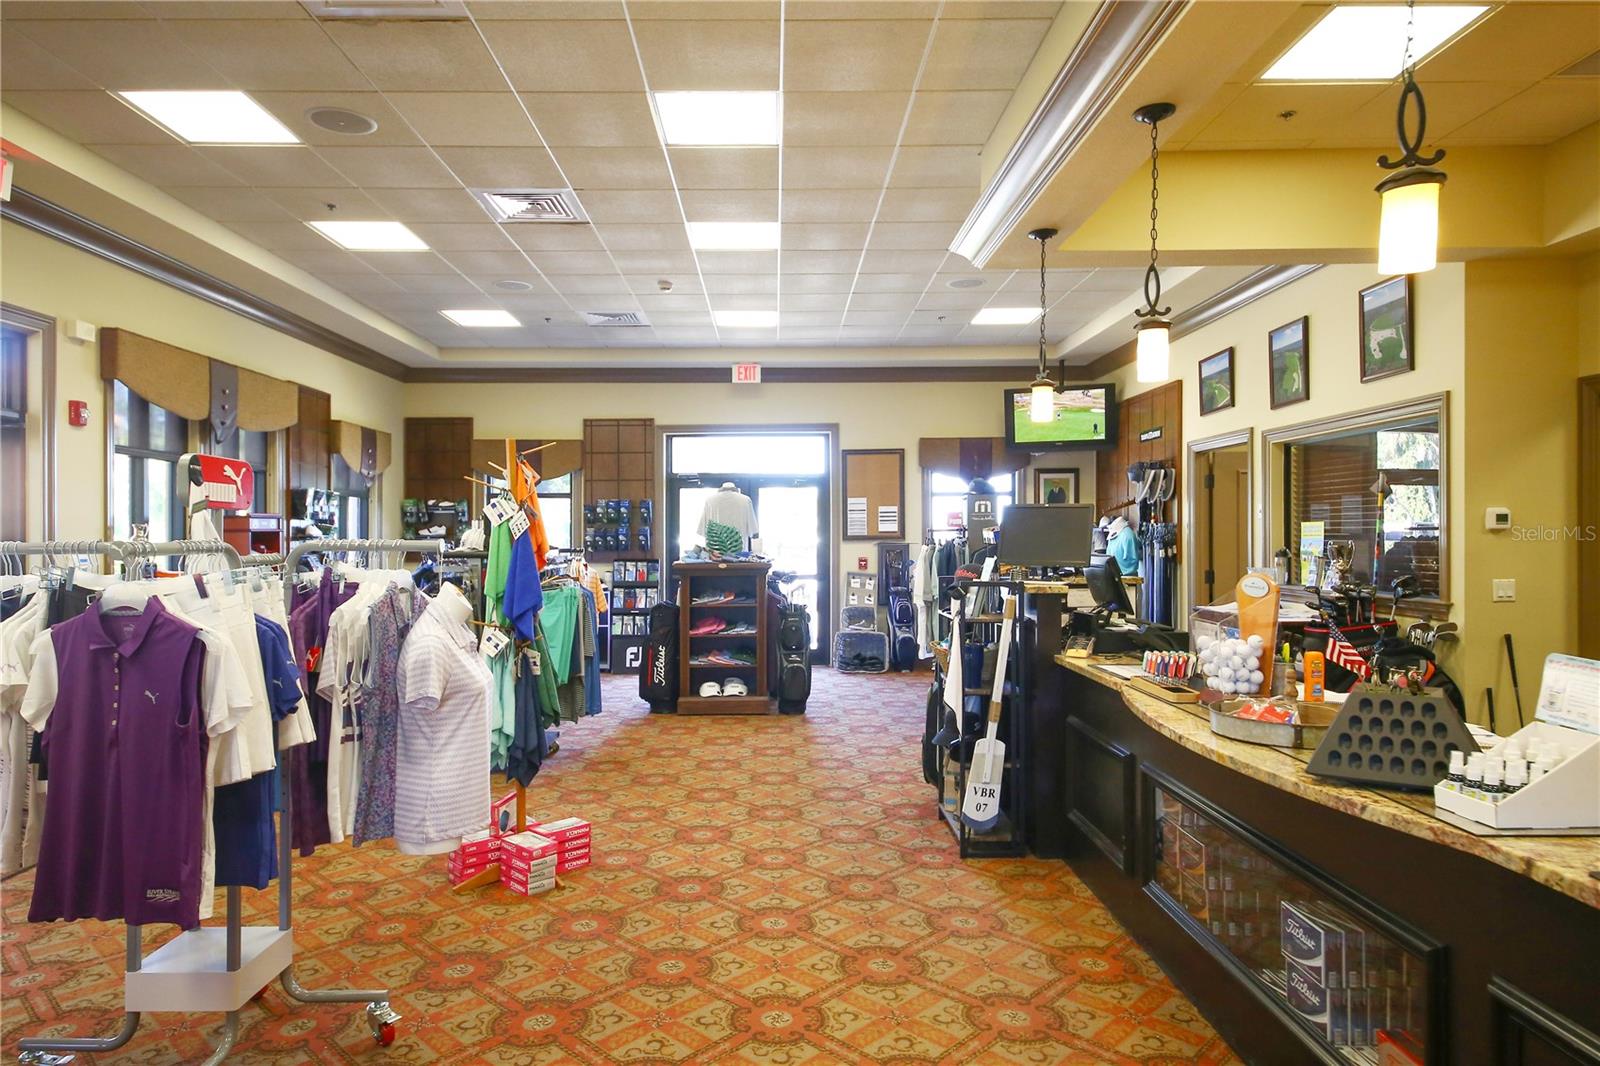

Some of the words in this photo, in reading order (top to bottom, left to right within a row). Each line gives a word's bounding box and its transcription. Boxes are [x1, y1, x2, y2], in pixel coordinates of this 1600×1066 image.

[736, 364, 757, 381] EXIT
[625, 646, 643, 667] FJ
[653, 645, 666, 687] Titleist
[973, 786, 995, 798] VBR
[975, 802, 988, 812] 07
[1285, 918, 1316, 951] Titleist
[1291, 972, 1320, 1006] Titleist
